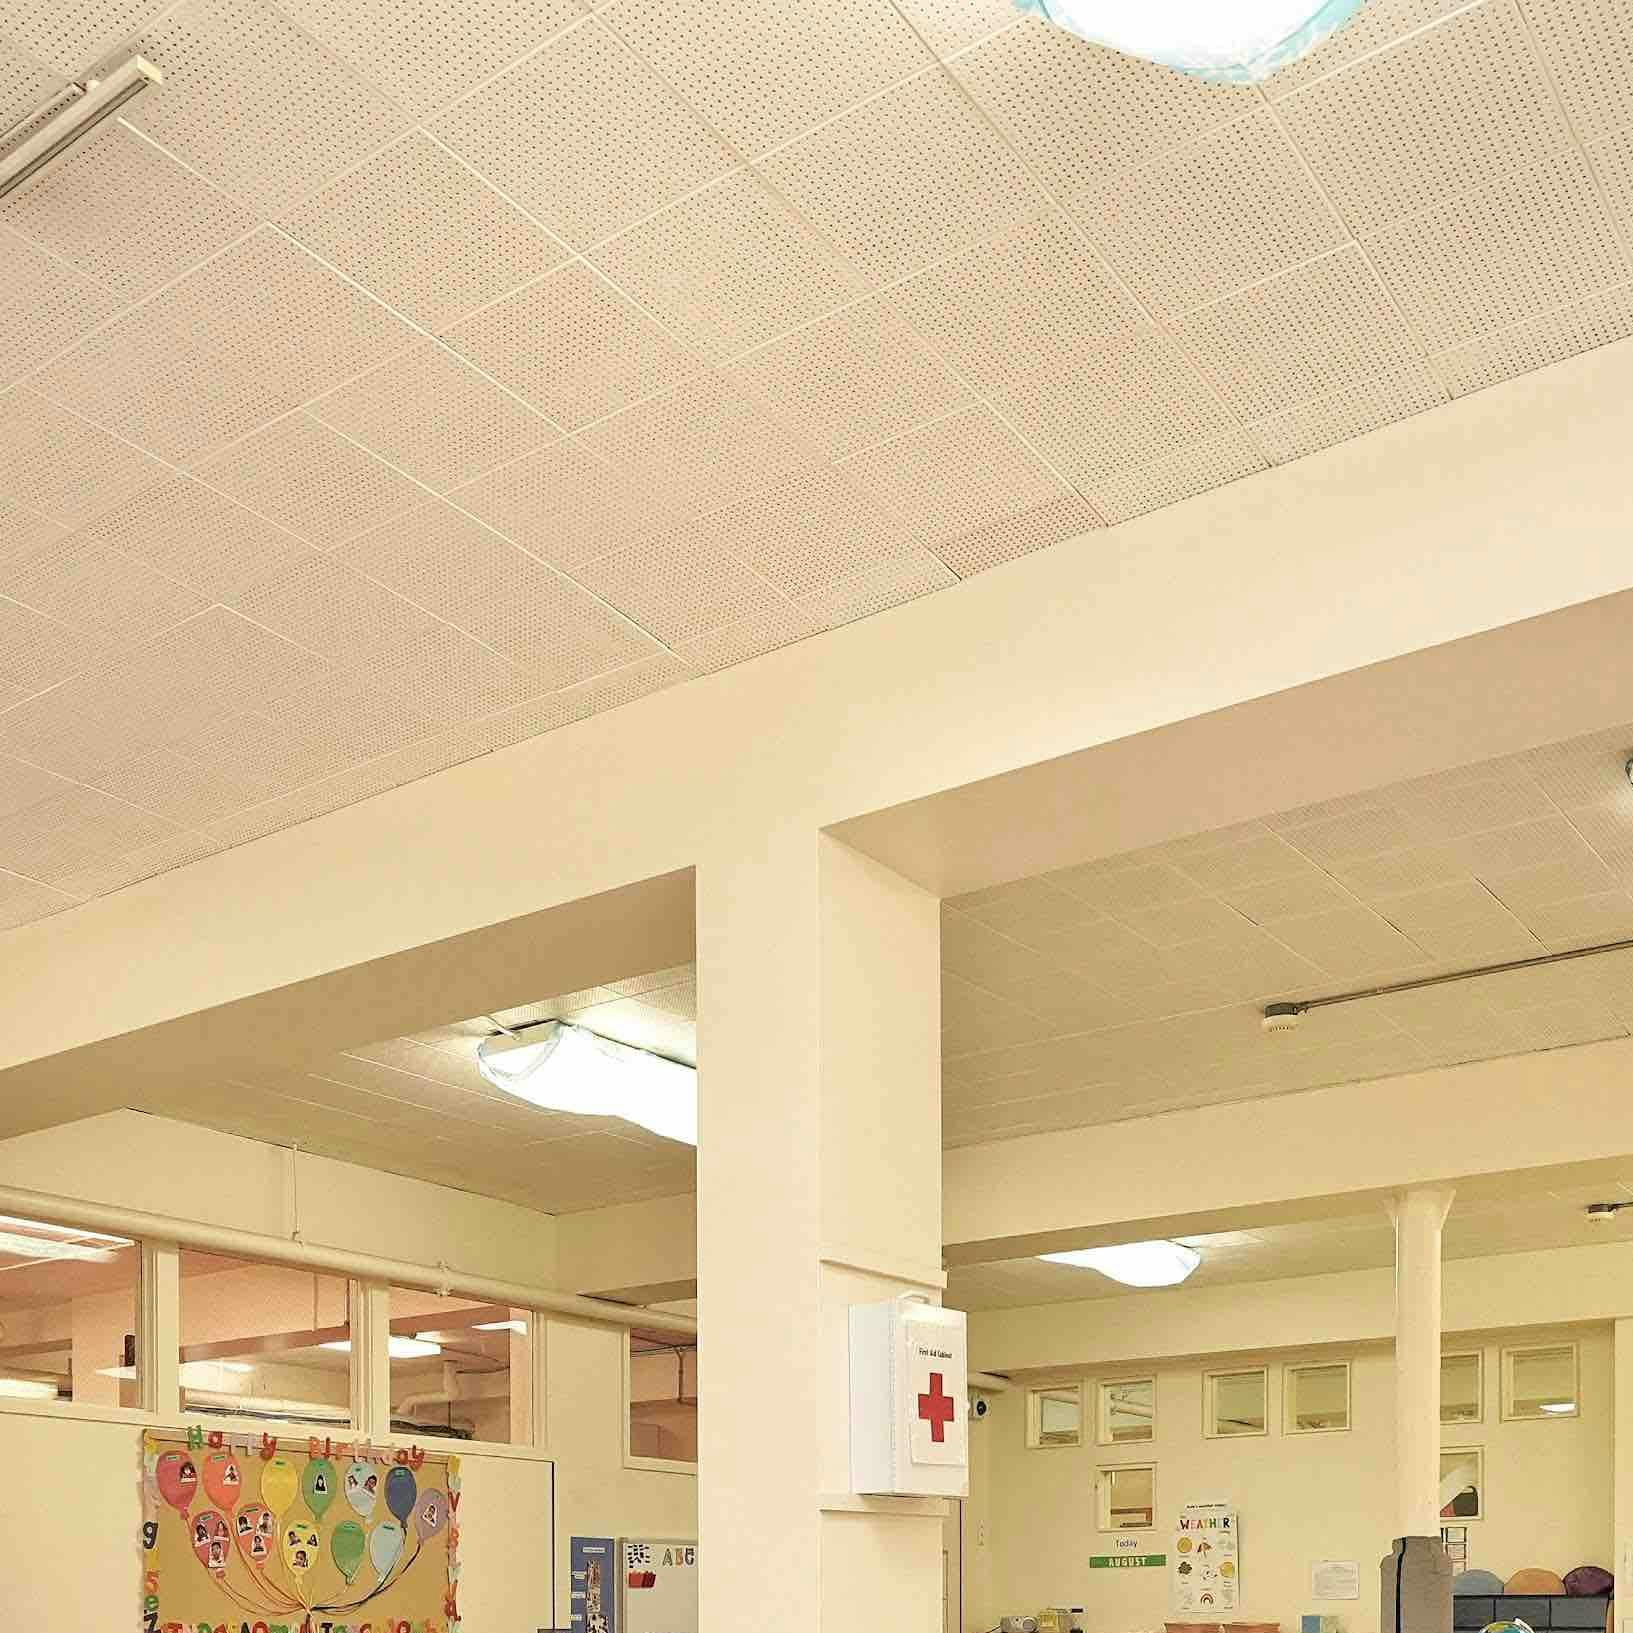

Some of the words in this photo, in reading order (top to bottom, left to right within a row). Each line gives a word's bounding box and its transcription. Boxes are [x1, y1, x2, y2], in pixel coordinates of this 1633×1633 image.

[1116, 1537, 1138, 1549] Today
[662, 1547, 695, 1567] ABC
[1108, 1556, 1147, 1567] AUGUST
